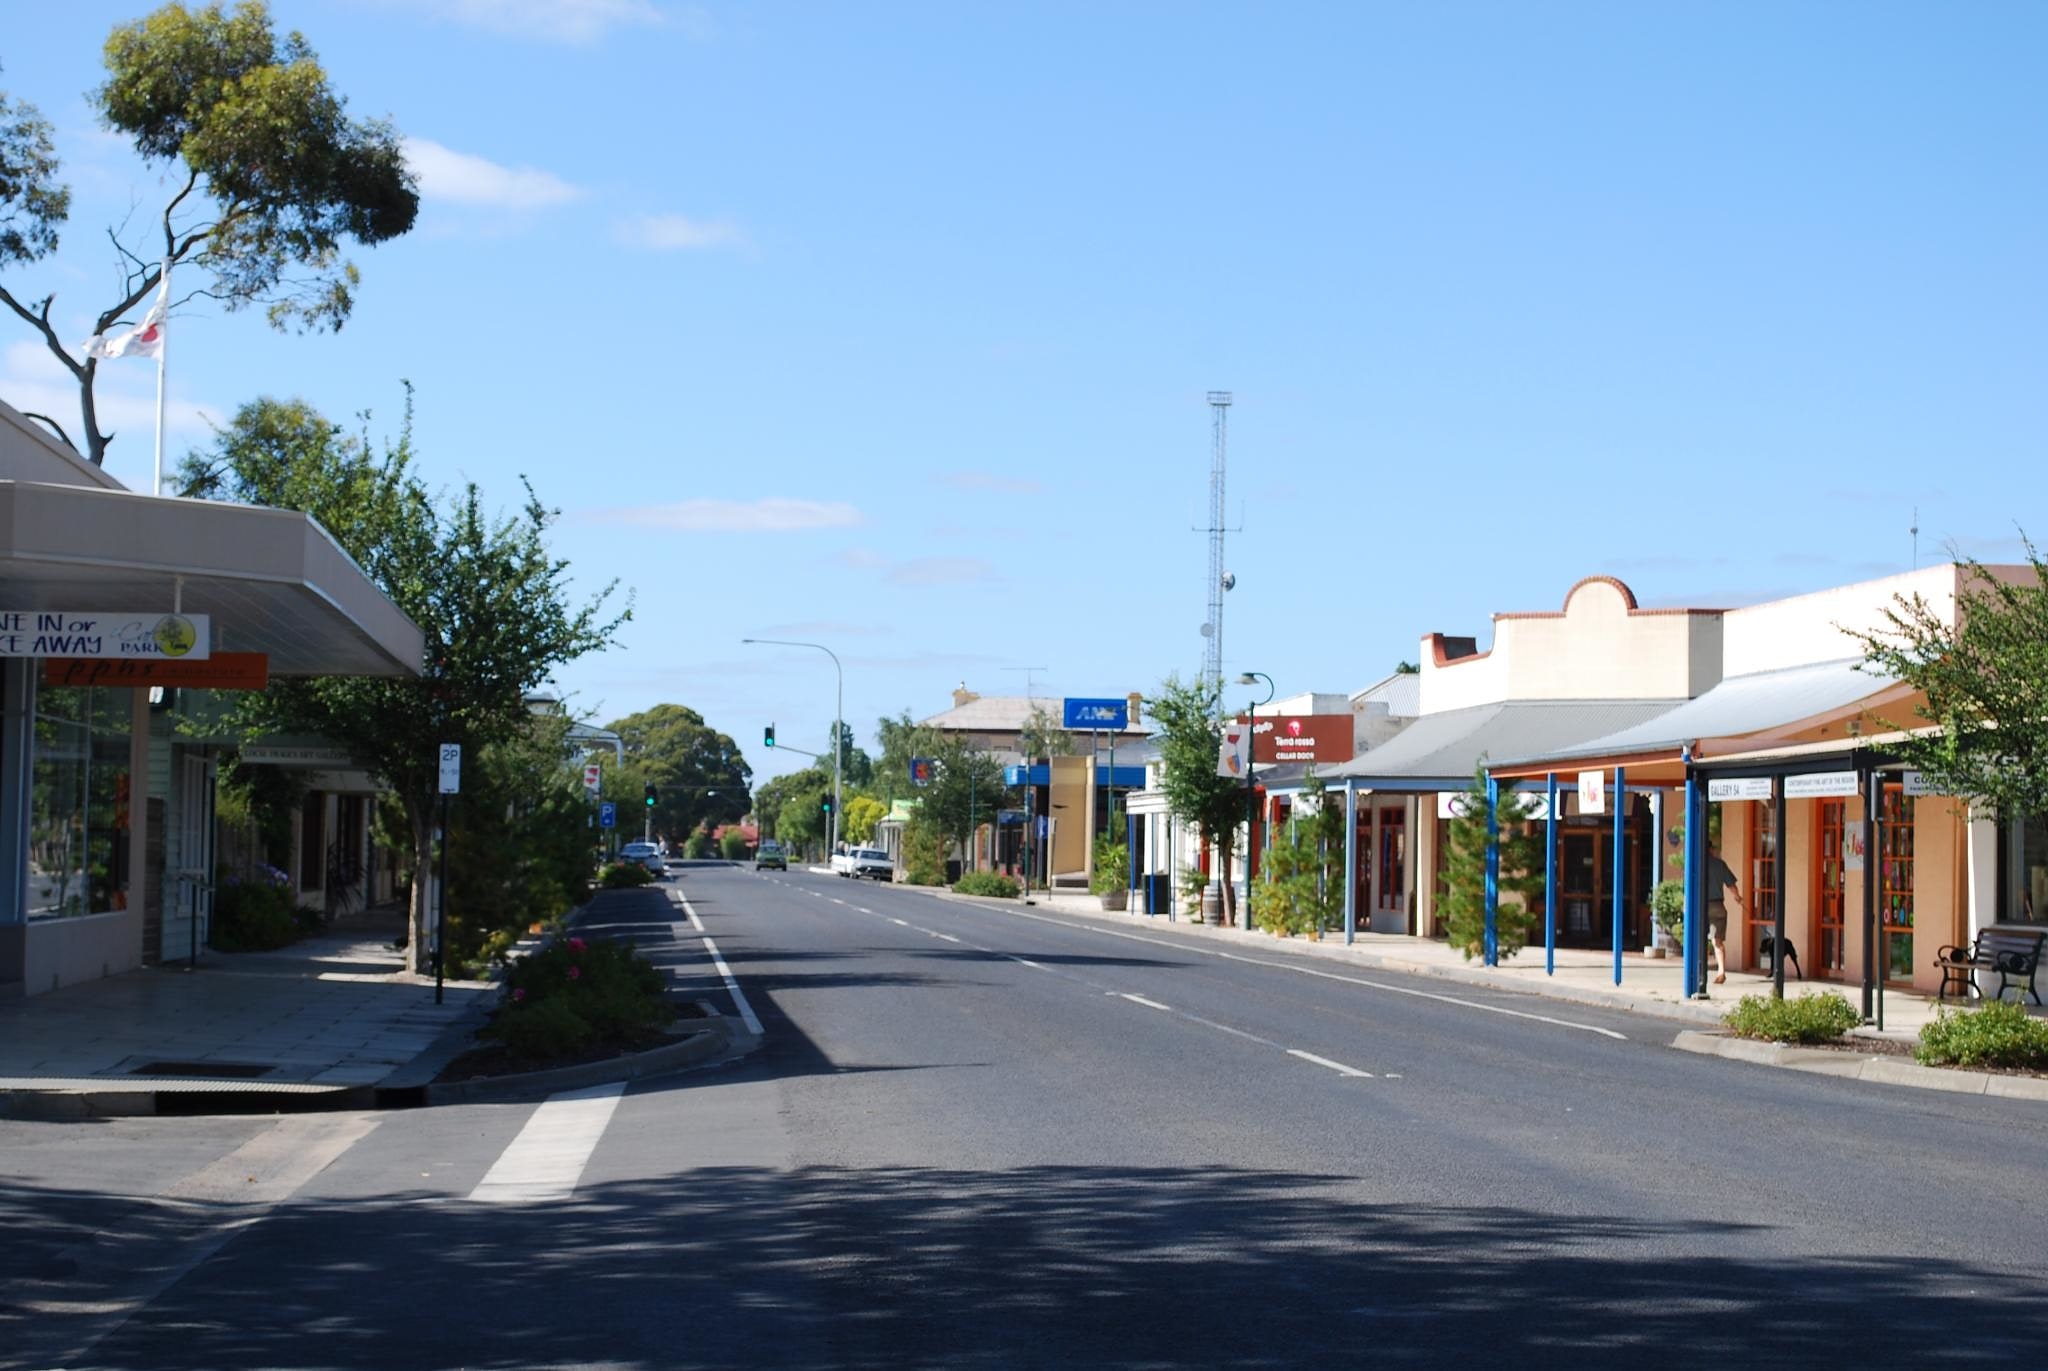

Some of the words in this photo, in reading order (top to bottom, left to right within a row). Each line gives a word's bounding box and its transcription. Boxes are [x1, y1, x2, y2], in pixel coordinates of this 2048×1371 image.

[38, 613, 63, 632] IN
[68, 621, 97, 633] or
[32, 635, 102, 654] AWAY
[443, 749, 458, 761] 2P
[1711, 783, 1732, 797] GALLERY
